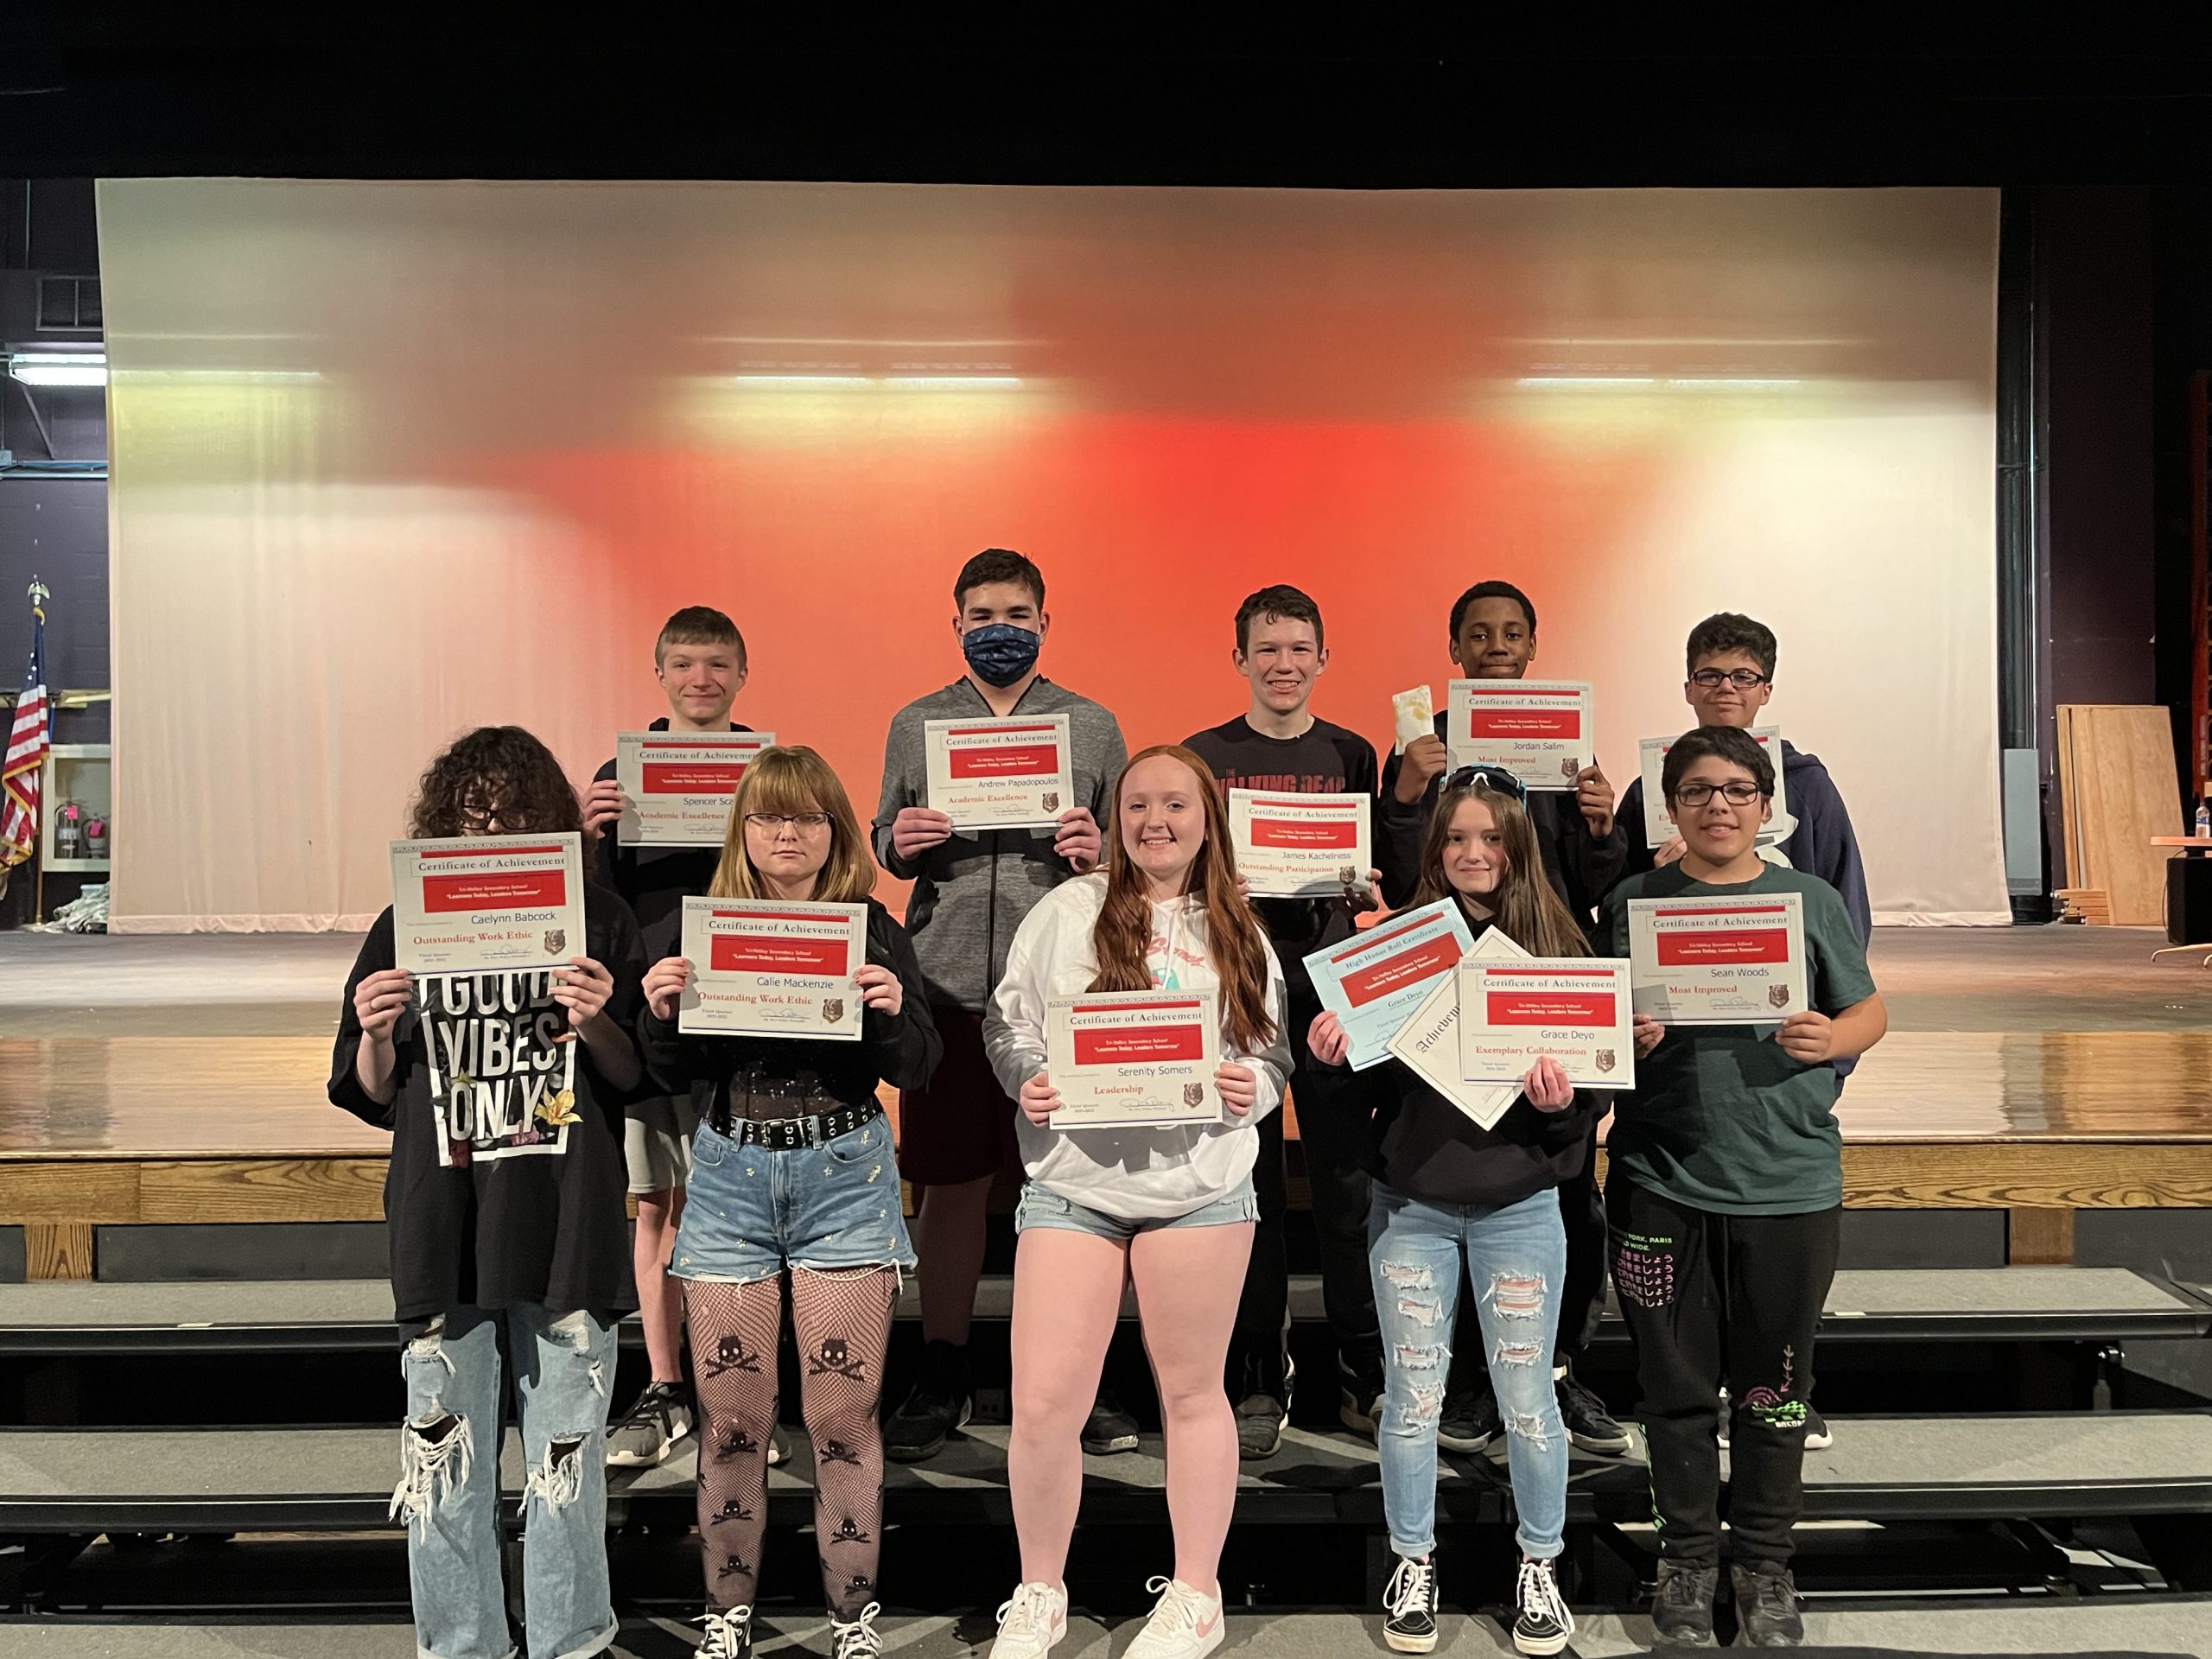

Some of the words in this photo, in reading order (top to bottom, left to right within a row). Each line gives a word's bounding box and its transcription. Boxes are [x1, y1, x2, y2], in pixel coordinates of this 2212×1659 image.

[1008, 779, 1058, 787] Papadopoulos
[419, 861, 475, 871] Certificate
[480, 860, 491, 868] of
[496, 857, 564, 868] Achievement
[471, 914, 511, 925] Caelynn
[515, 912, 556, 922] Babcock
[1654, 919, 1704, 928] Certificate
[1723, 917, 1787, 925] Achievement
[709, 921, 763, 931] Certificate
[783, 925, 849, 935] Achievement
[414, 934, 475, 944] Outstanding
[1346, 958, 1363, 969] High
[1364, 950, 1386, 962] Honor
[1388, 941, 1401, 950] Roll
[1402, 926, 1438, 944] Certificate
[1711, 969, 1733, 977] Sean
[1738, 968, 1769, 976] Woods
[757, 976, 780, 987] Calie
[784, 978, 834, 988] Mackenzie
[442, 975, 557, 1015] GOOD
[1694, 984, 1737, 995] Improved
[699, 992, 756, 1003] Outstanding
[1389, 998, 1406, 1007] Grace
[1407, 990, 1423, 1000] Deyo
[1071, 1015, 1122, 1025] Certificate
[1140, 1013, 1202, 1021] Achievement
[1541, 1030, 1567, 1039] Grace
[1571, 1031, 1594, 1041] Deyo
[438, 1012, 560, 1078] VIBES
[1476, 1046, 1523, 1055] Exemplary
[1527, 1046, 1586, 1055] Collaboration
[1118, 1068, 1154, 1077] Serenity
[1159, 1066, 1192, 1075] Somers
[1094, 1086, 1143, 1095] Leadership
[450, 1075, 547, 1141] ONLY
